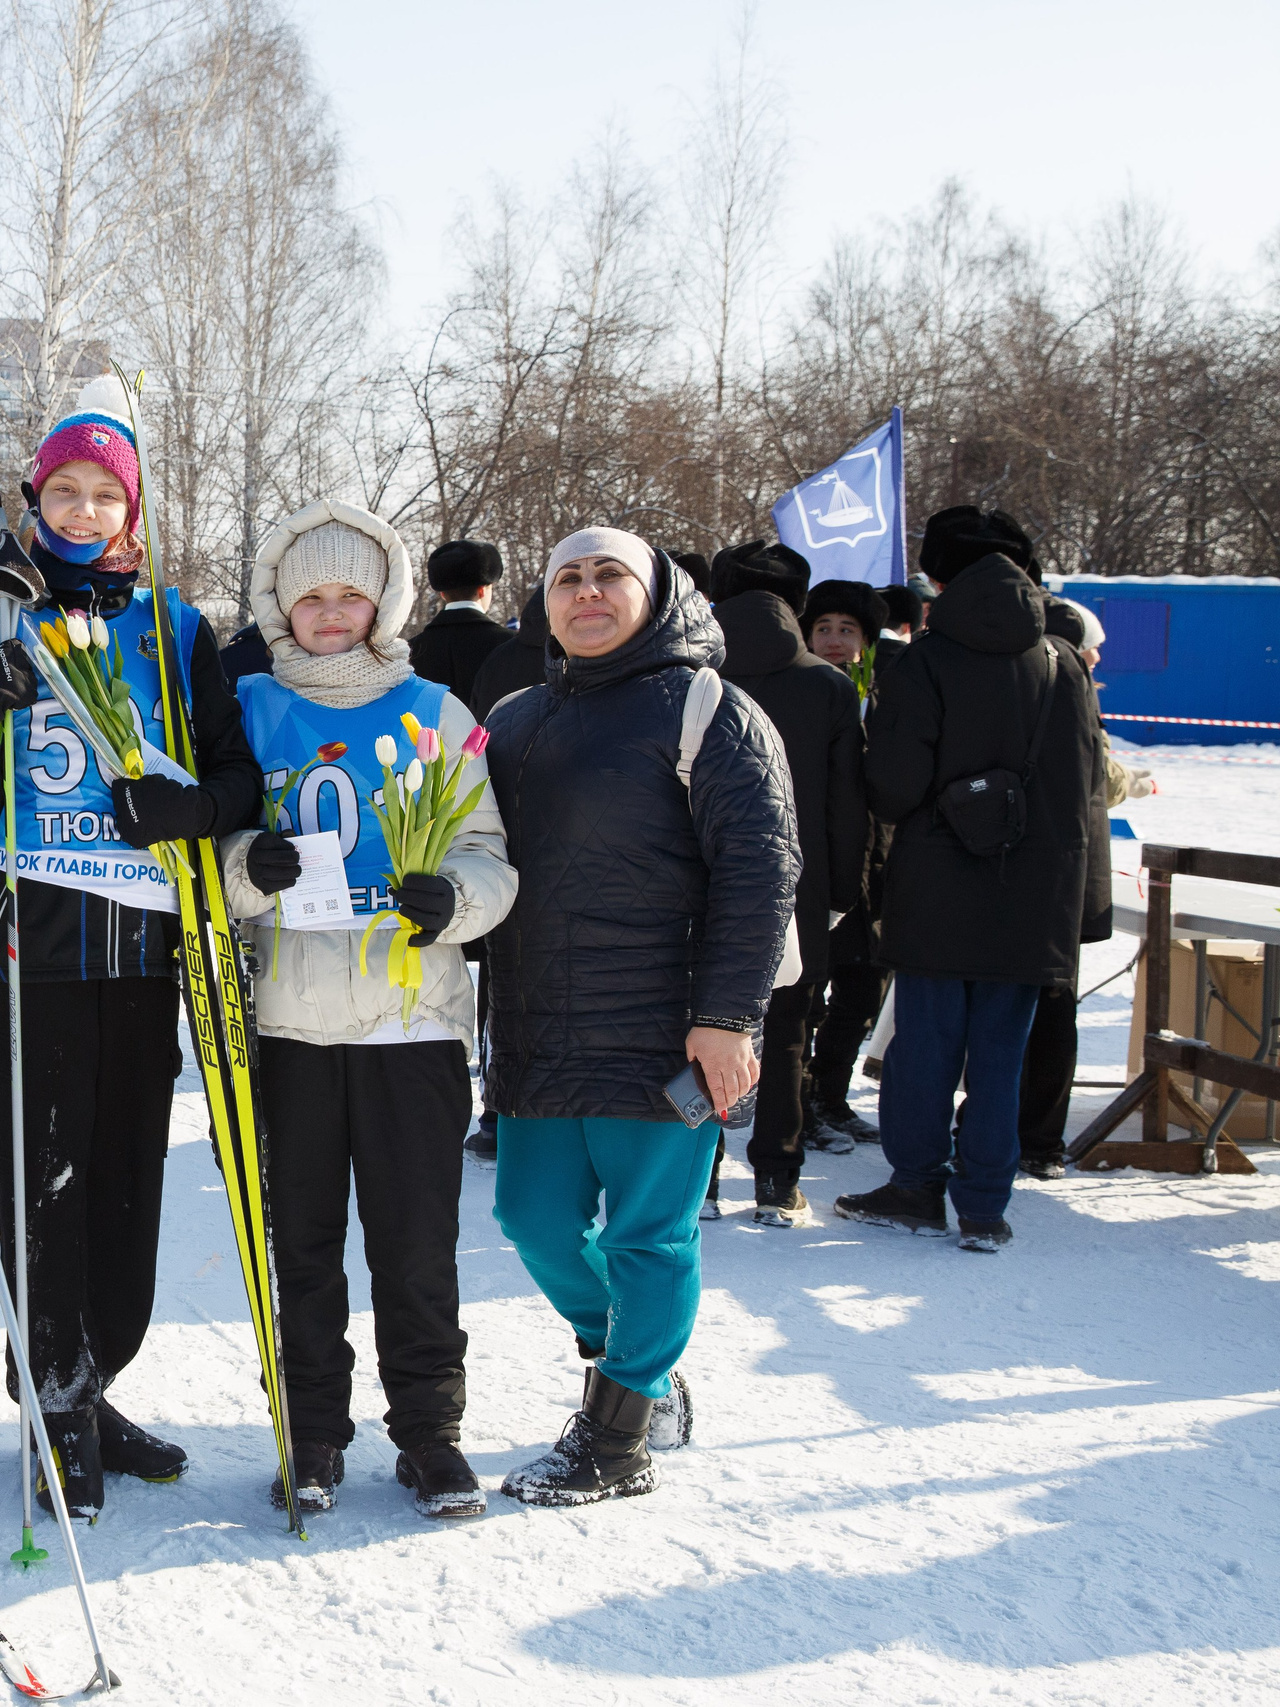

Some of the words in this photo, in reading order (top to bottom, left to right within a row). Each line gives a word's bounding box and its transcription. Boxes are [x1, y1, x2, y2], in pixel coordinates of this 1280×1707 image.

[125, 786, 139, 823] NORDSK
[46, 857, 108, 878] ГЛАВЫ
[113, 863, 168, 887] ГОРОД
[186, 930, 218, 1069] FISCHER
[215, 930, 247, 1069] FISCHER
